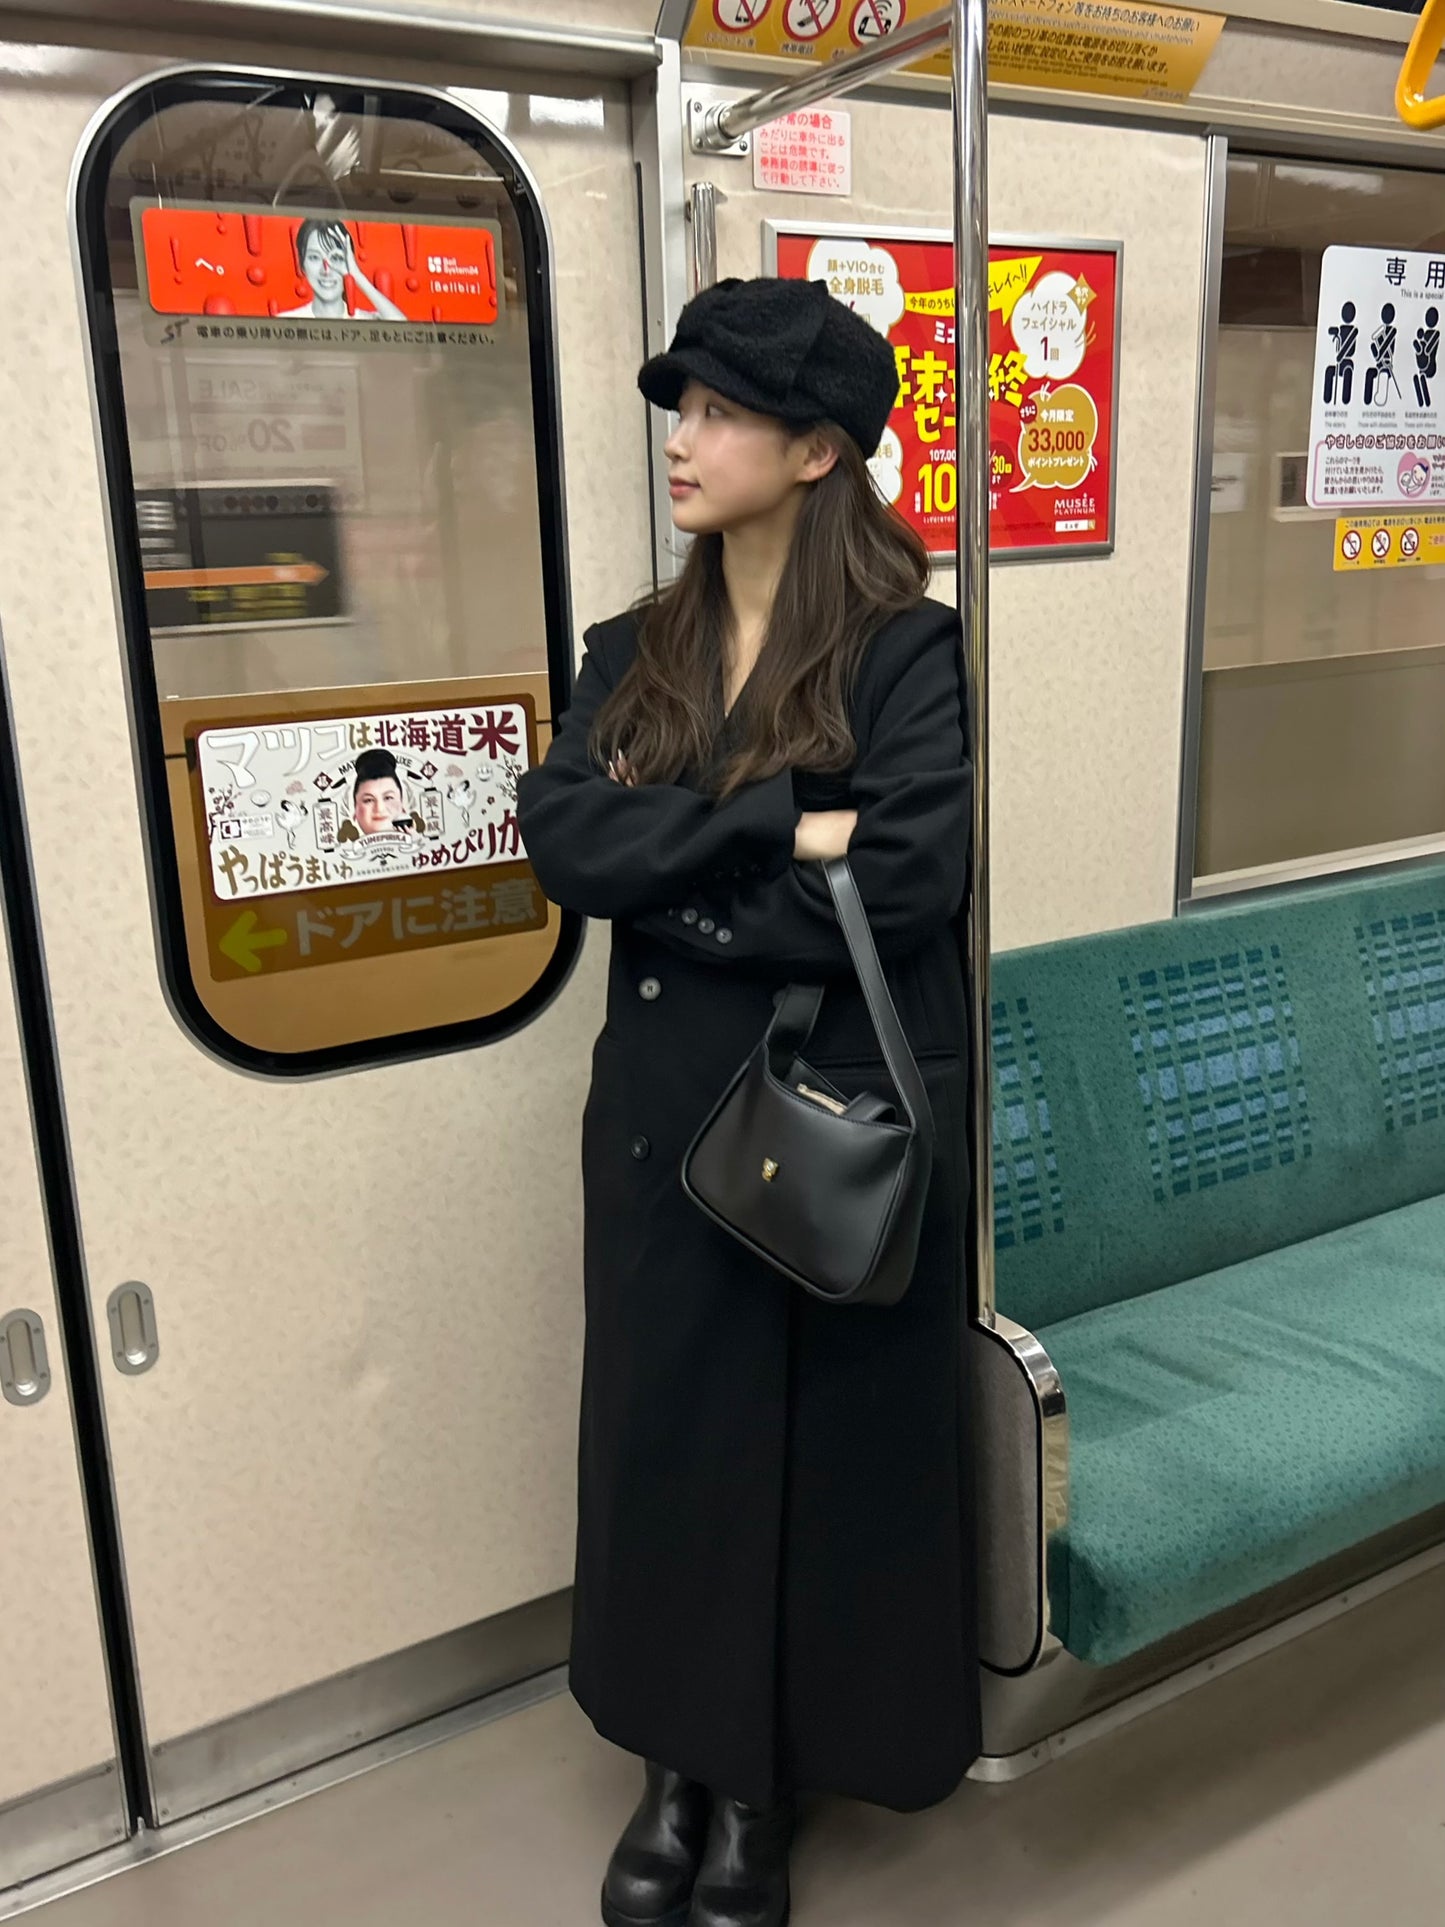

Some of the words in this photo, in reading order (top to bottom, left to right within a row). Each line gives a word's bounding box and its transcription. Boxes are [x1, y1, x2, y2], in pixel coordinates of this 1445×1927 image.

[760, 143, 829, 159] ことは危険です。
[829, 276, 885, 296] 全身脱毛
[1031, 300, 1068, 316] ハイドラ
[1021, 316, 1077, 332] フェイシャル
[1040, 409, 1075, 423] 今月限定
[1028, 427, 1085, 455] 33,000
[1027, 456, 1085, 469] ポイントプレゼント
[1054, 507, 1096, 516] PLATINUM
[206, 710, 521, 789] マツコは北海道米
[218, 845, 354, 896] やっぱうまいわ
[296, 877, 538, 957] ドアに注意
